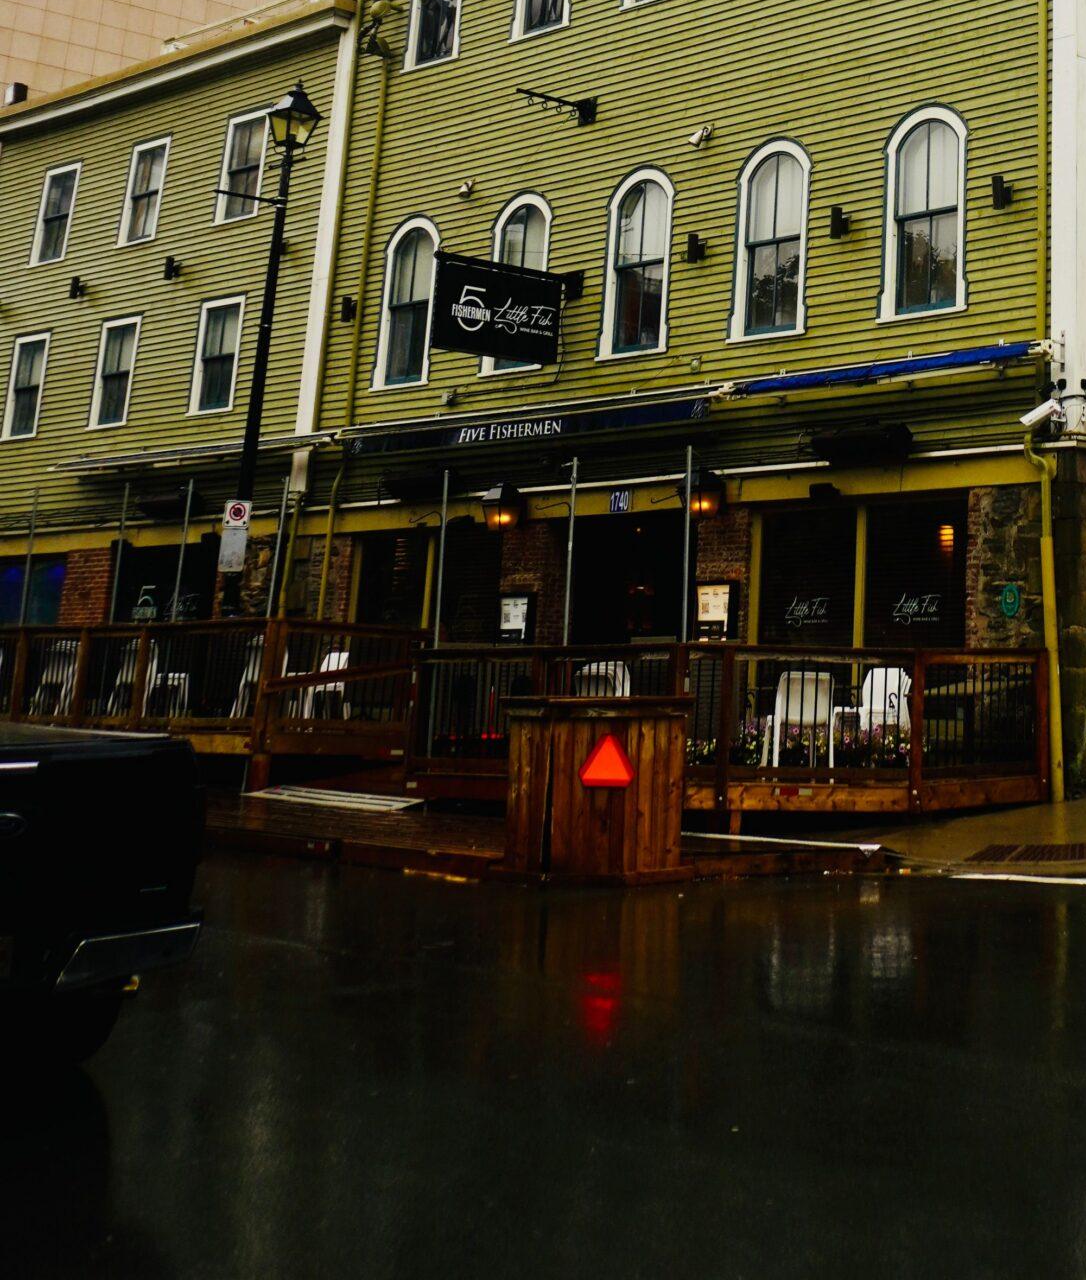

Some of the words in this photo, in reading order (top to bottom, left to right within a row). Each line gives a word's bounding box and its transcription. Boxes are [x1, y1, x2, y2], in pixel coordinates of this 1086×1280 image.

[451, 303, 491, 322] FISHERMEN
[458, 285, 487, 332] 5
[493, 297, 529, 335] Little
[530, 305, 557, 326] Fish
[458, 427, 486, 443] FIVE
[489, 419, 562, 440] FISHERMEN
[610, 490, 629, 512] 1740
[784, 594, 809, 628] Little
[892, 592, 920, 626] Little
[920, 593, 942, 614] Fish
